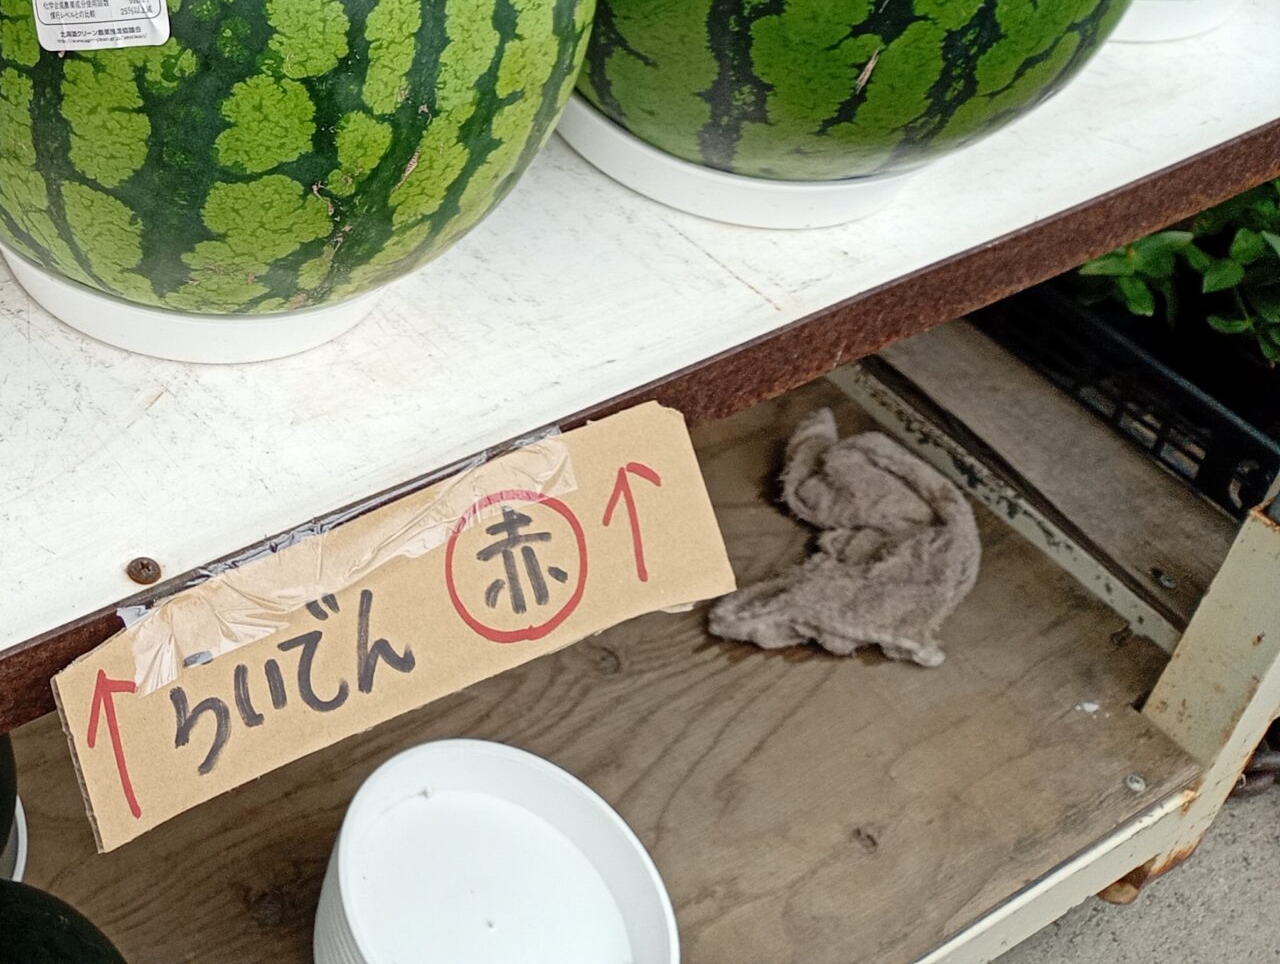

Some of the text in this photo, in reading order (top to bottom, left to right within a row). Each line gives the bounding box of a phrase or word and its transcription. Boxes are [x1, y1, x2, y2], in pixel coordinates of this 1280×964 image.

[476, 505, 568, 615] 赤
[169, 587, 417, 776] らいでん
